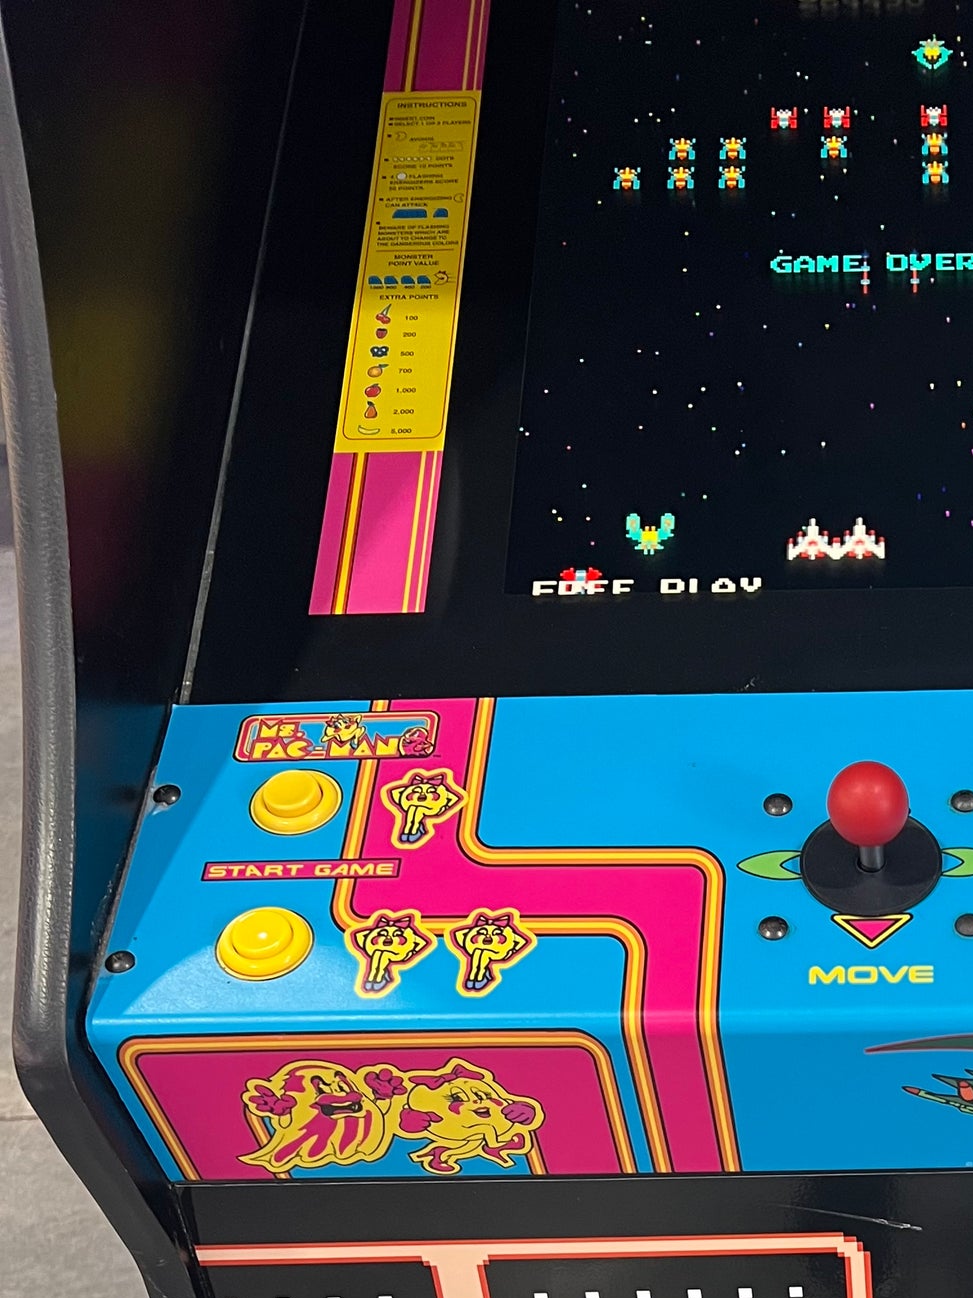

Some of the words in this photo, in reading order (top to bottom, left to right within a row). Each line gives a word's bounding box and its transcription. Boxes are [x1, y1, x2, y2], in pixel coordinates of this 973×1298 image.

[770, 255, 867, 273] GAME
[252, 736, 400, 759] PAC-MAN
[208, 864, 304, 878] START
[314, 863, 395, 877] GAME
[808, 965, 935, 986] MOVE
